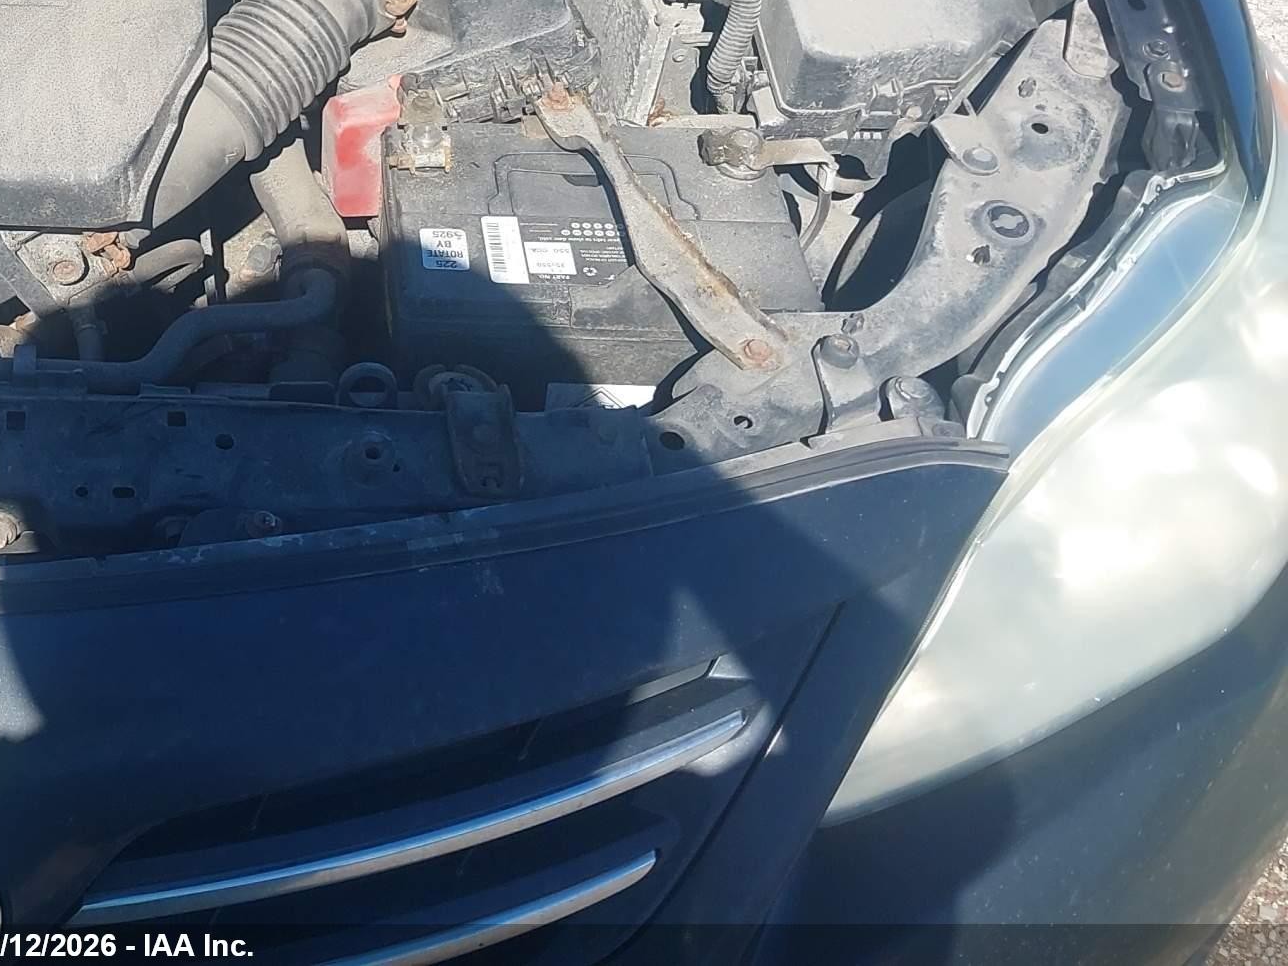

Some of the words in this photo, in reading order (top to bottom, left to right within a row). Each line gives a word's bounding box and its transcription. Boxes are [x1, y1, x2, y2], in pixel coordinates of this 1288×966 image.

[437, 240, 452, 248] BY
[426, 249, 464, 258] ROTATE
[435, 260, 457, 269] 225
